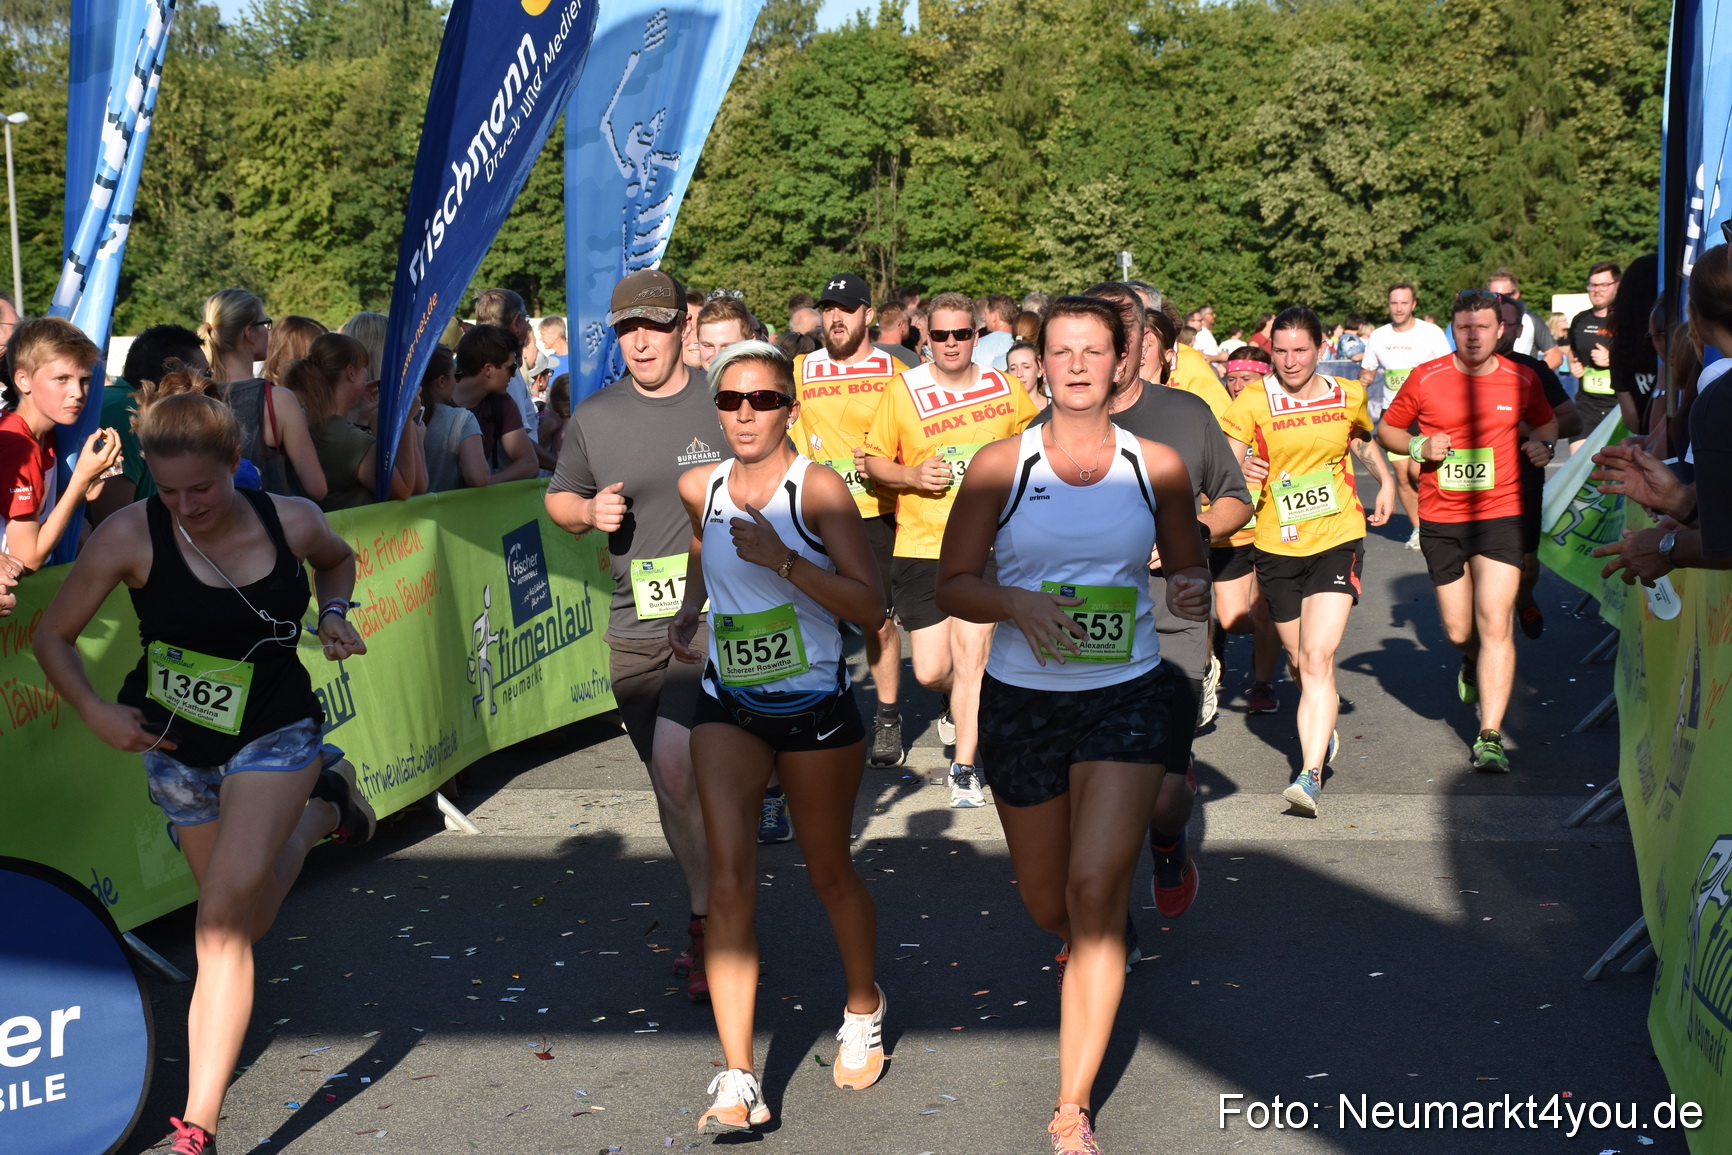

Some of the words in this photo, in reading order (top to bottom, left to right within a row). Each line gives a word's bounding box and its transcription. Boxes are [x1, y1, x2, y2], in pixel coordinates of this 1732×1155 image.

[485, 116, 521, 183] Druck
[521, 66, 543, 118] und
[803, 385, 842, 400] MAX
[923, 415, 966, 438] MAX
[971, 402, 1015, 422] BÖGL
[1272, 419, 1307, 432] MAX
[1311, 412, 1348, 425] BÖGL
[677, 451, 720, 462] BURKHARDT
[845, 470, 864, 486] 46
[1444, 464, 1486, 479] 1502
[1282, 486, 1330, 511] 1265
[374, 529, 424, 571] Firmen
[513, 552, 538, 577] Fischer
[352, 588, 402, 640] laufen
[395, 552, 442, 617] länger!
[649, 599, 680, 608] Burkhardt
[498, 580, 593, 682] firmenlauf
[1058, 611, 1124, 641] 553
[723, 632, 792, 666] 1552
[1080, 642, 1116, 650] Alexandra
[727, 666, 755, 675] Scherzer
[756, 658, 792, 672] Roswitha
[158, 668, 233, 712] 1362
[502, 663, 543, 705] neumarkt
[570, 668, 612, 703] www.firm
[182, 700, 219, 718] Katharina
